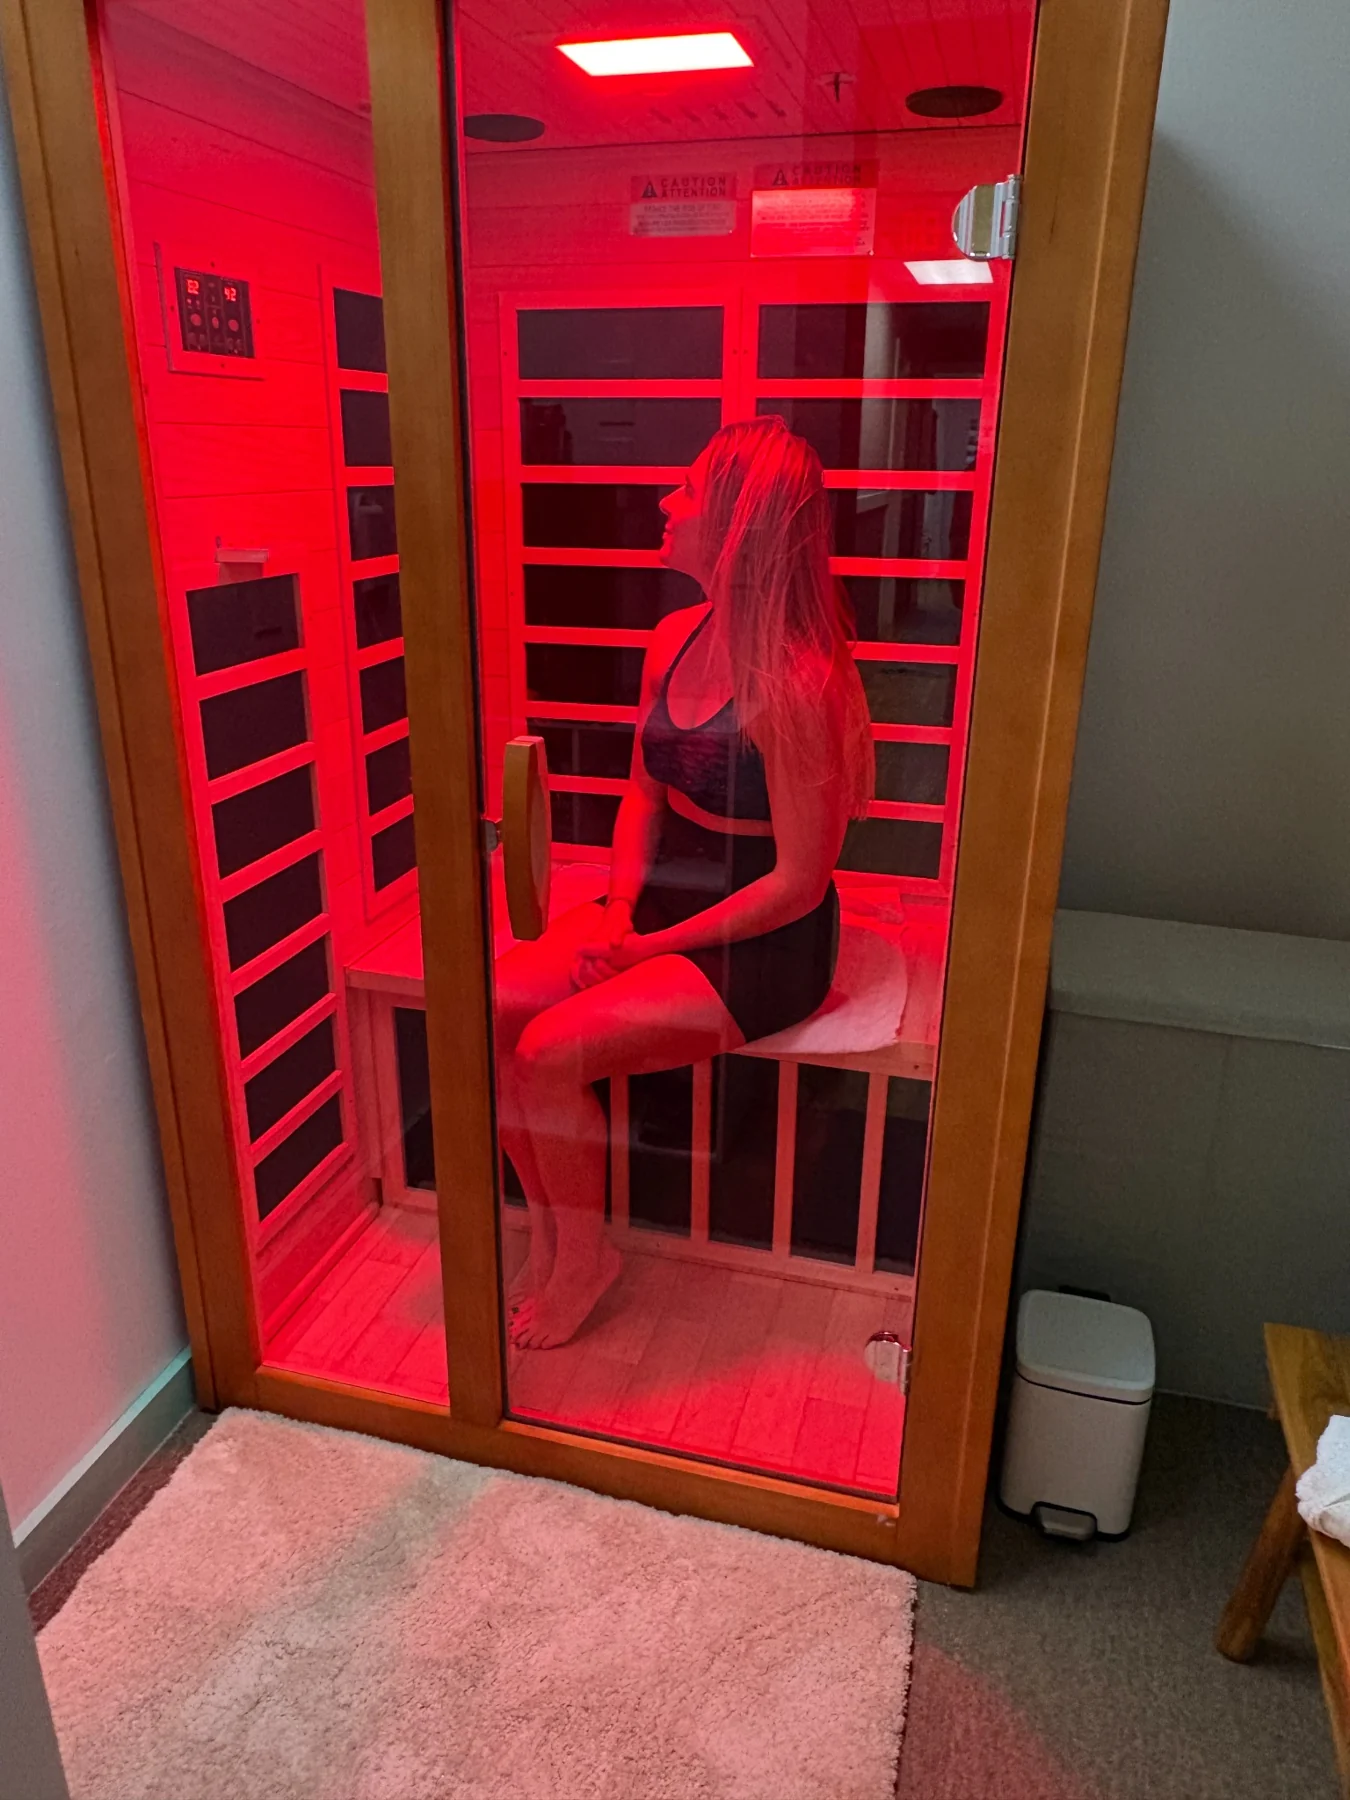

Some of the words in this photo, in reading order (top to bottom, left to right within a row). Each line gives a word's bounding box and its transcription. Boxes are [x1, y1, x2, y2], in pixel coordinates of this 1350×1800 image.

[792, 163, 862, 175] CAUTION
[660, 176, 727, 188] CAUTION
[792, 174, 862, 186] ATTENTION
[661, 186, 727, 198] ATTENTION
[224, 288, 237, 302] 42
